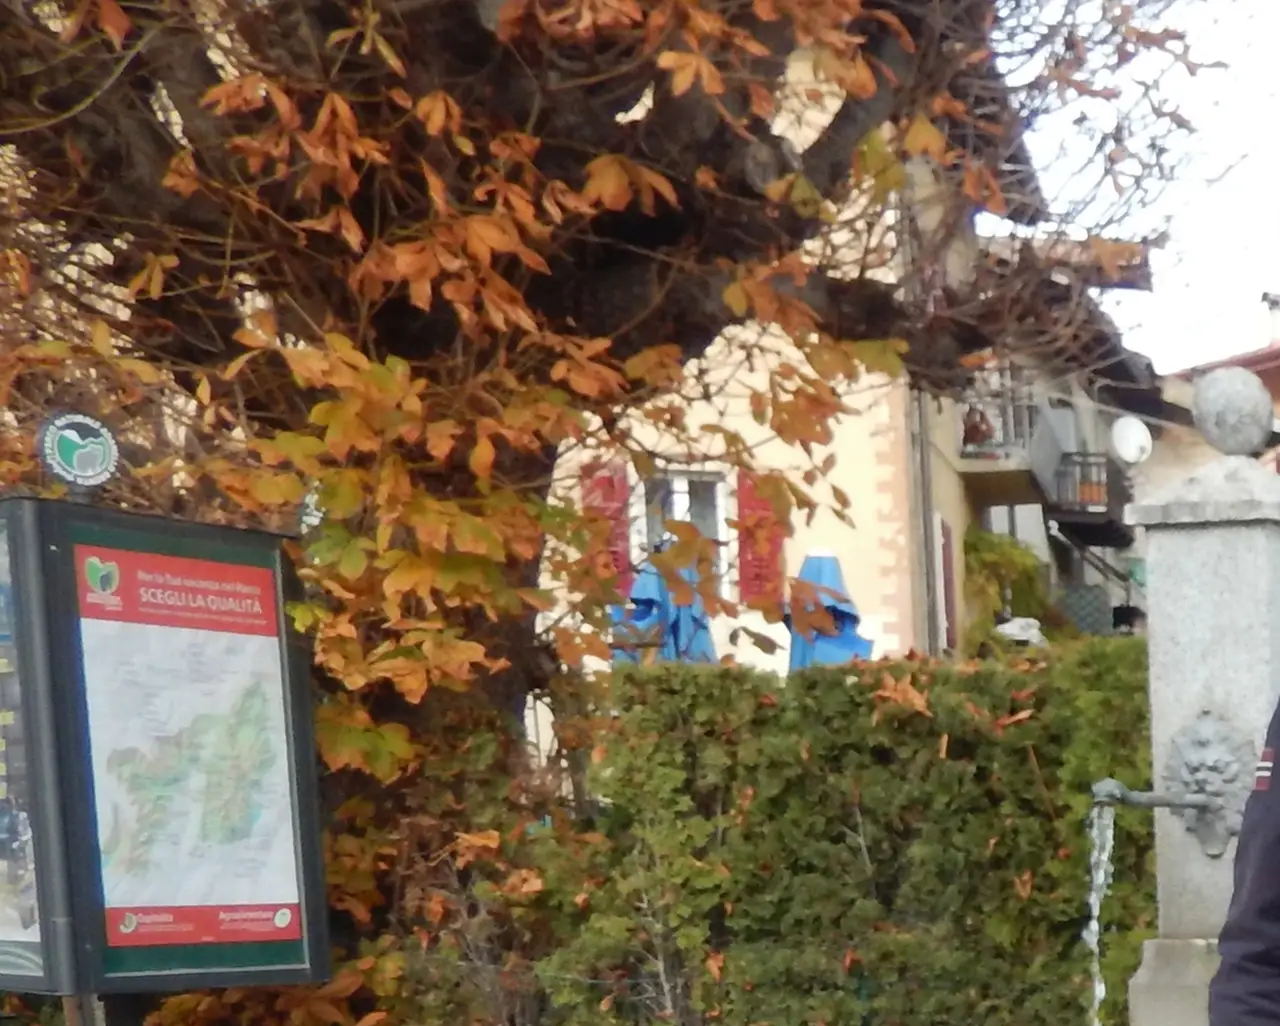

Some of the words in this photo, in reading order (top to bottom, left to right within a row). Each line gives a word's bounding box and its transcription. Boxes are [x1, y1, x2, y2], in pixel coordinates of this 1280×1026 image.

[139, 587, 185, 606] SCEGLI
[189, 592, 205, 608] LA
[207, 594, 263, 614] QUALITÀ
